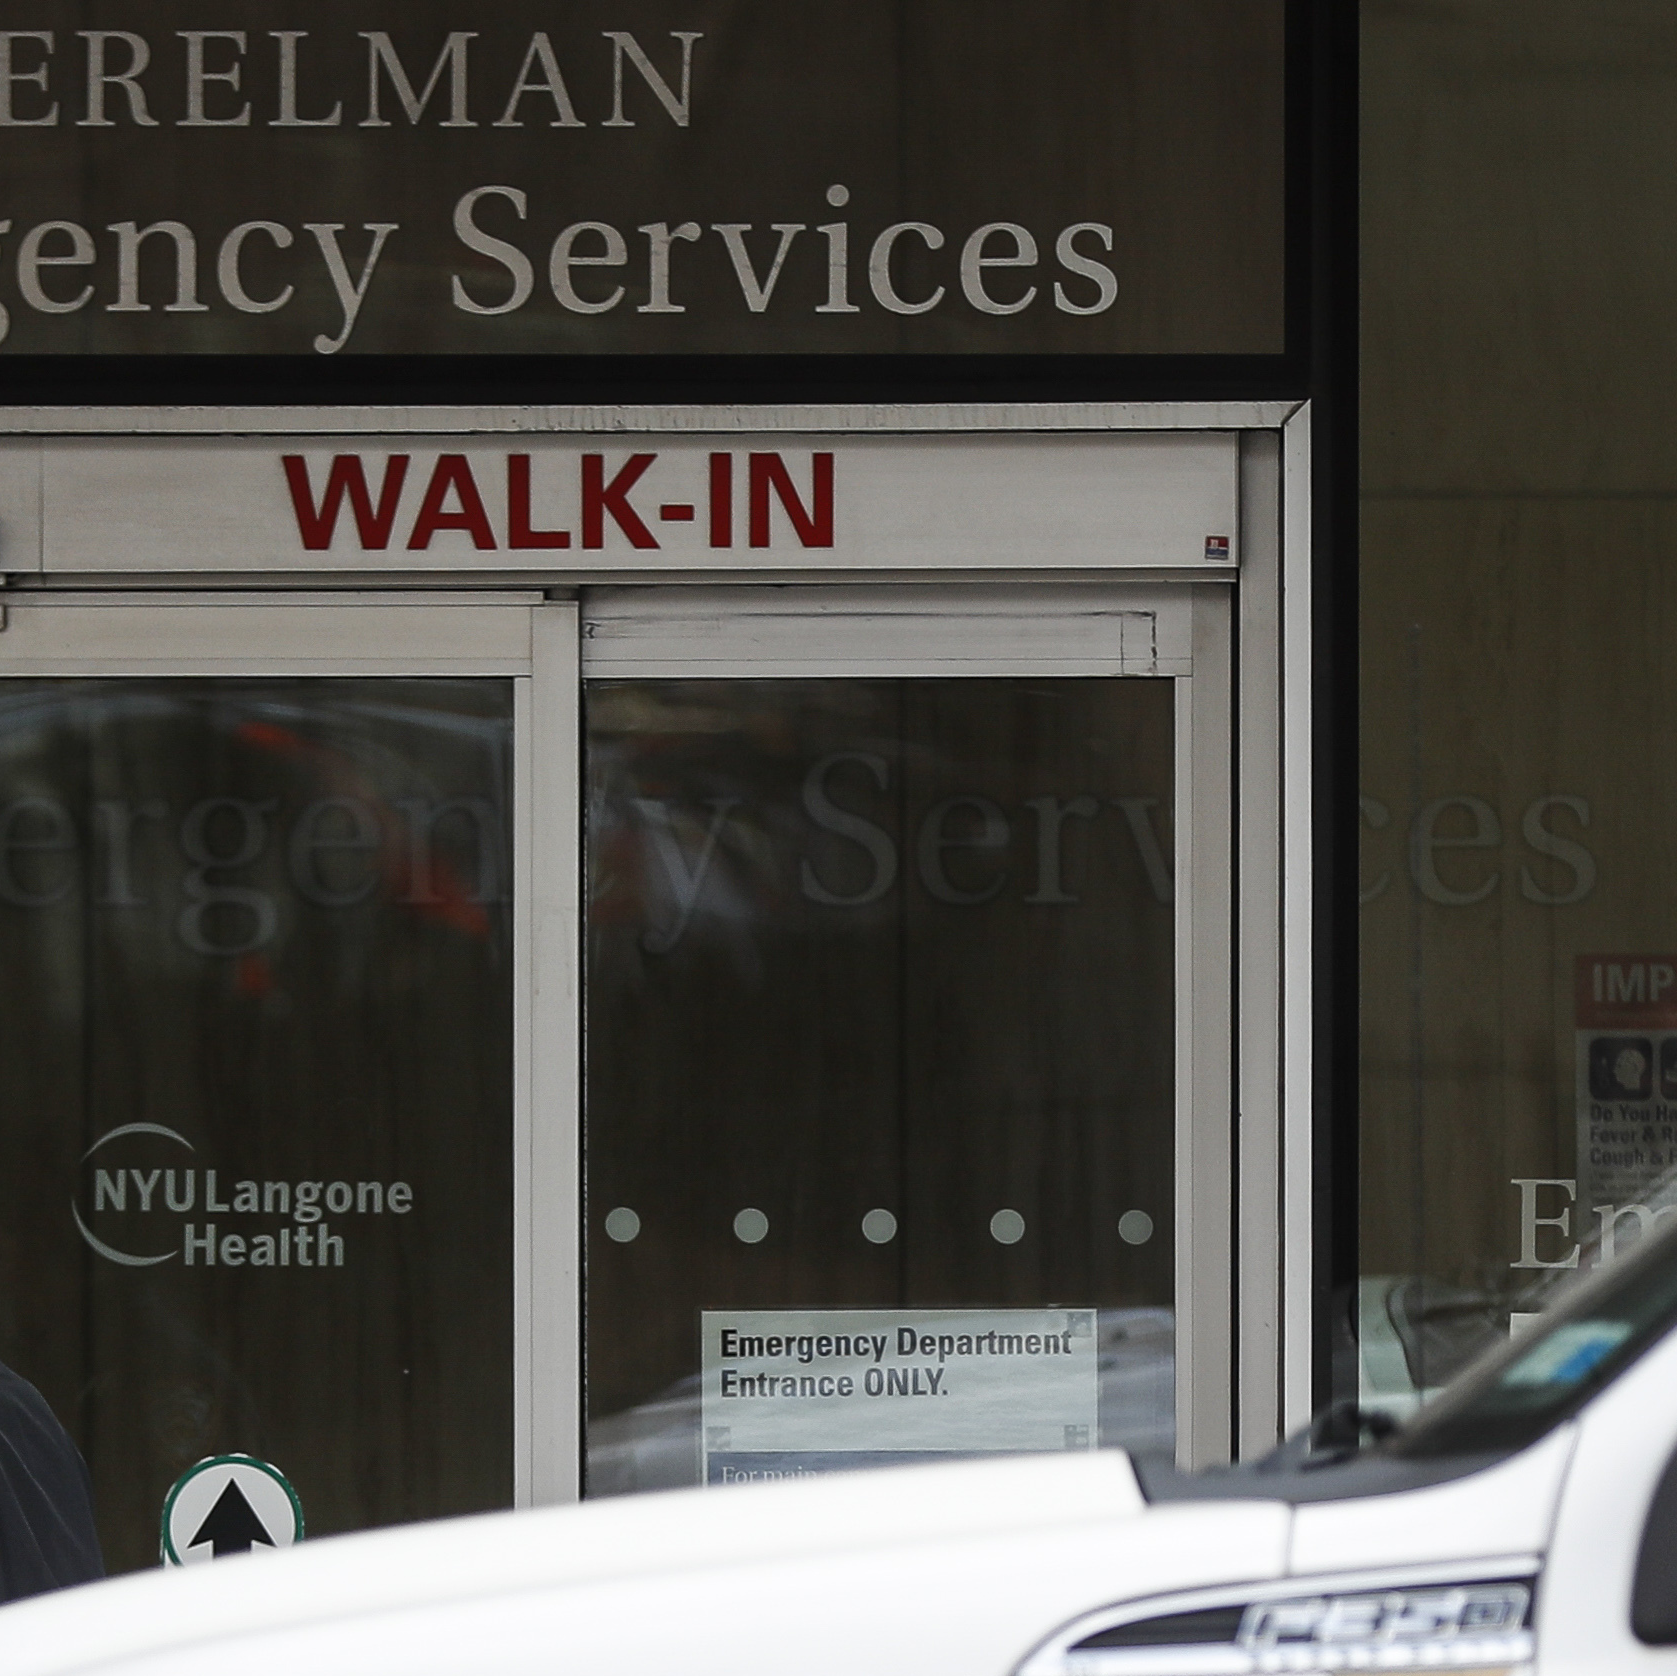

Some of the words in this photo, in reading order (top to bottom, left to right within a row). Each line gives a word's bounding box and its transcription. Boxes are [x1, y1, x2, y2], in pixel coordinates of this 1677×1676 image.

[449, 183, 1121, 318] Services
[281, 450, 836, 551] WALK-IN
[1589, 1103, 1613, 1121] Do
[1618, 1103, 1651, 1121] You
[1589, 1125, 1636, 1143] Fever
[1589, 1147, 1645, 1169] Cough
[94, 1168, 196, 1213] NYU
[205, 1168, 415, 1223] Langone
[184, 1223, 345, 1267] Health
[720, 1327, 888, 1364] Emergency
[896, 1326, 1073, 1364] Department
[720, 1368, 855, 1399] Entrance
[863, 1366, 949, 1397] ONLY.
[722, 1466, 758, 1486] For
